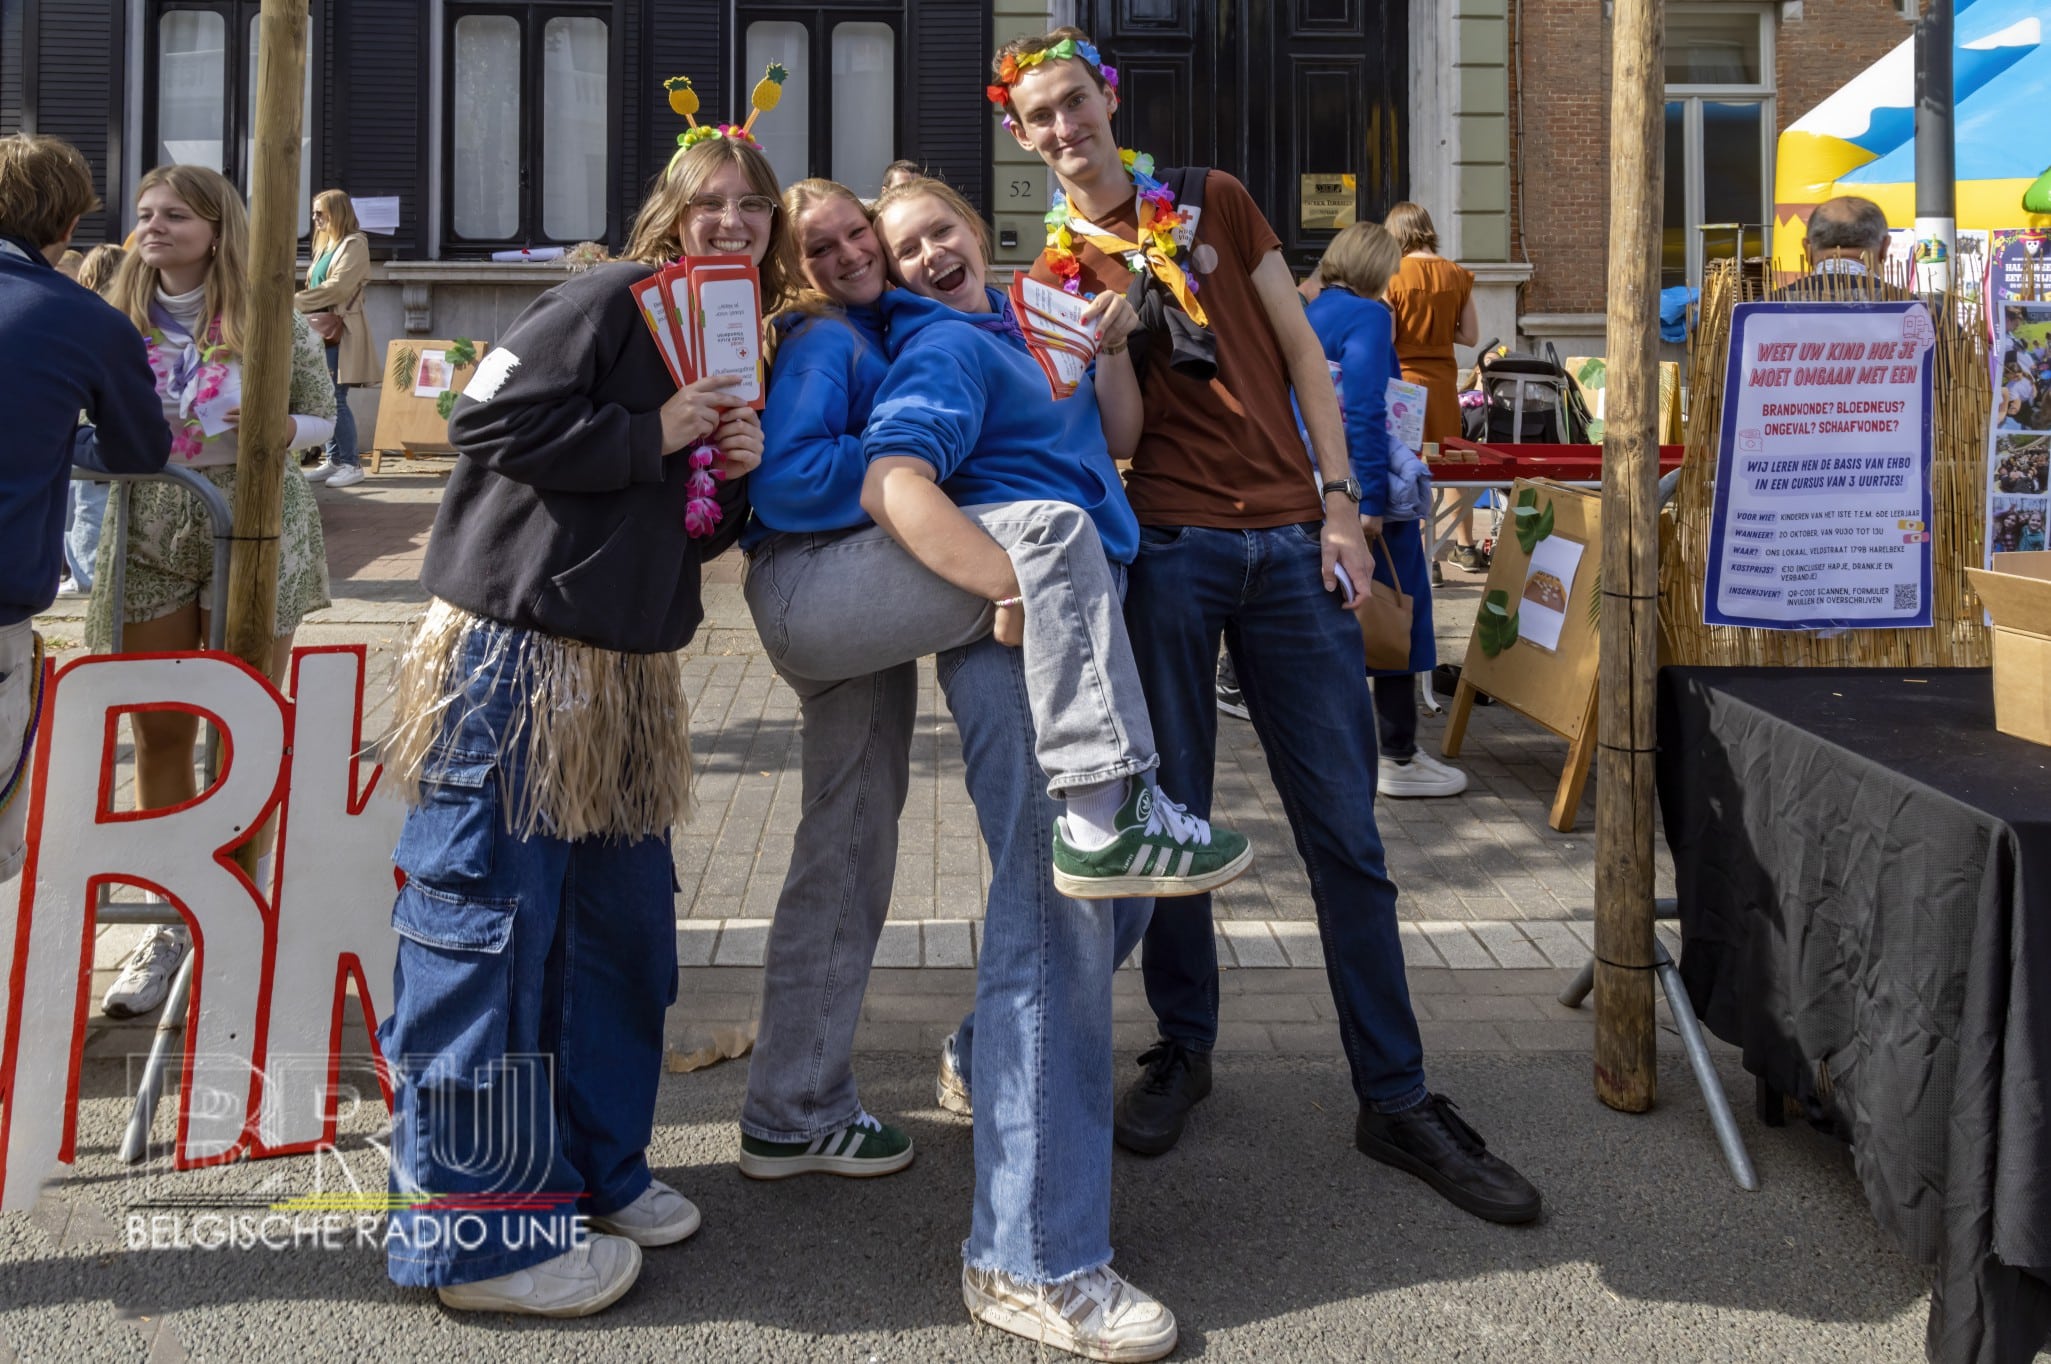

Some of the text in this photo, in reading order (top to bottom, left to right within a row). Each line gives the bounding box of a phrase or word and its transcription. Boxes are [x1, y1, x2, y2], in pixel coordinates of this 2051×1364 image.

[1009, 180, 1032, 198] 52
[1758, 341, 1917, 361] WEET UW KIND HOE JE
[1749, 366, 1917, 386] MOET OMGAAN MET EEN
[1763, 401, 1905, 416] BRANDWONDE? BLOEDNEUS?
[1765, 420, 1899, 435] ONGEVAL? SCHAAFWONDE?
[1747, 457, 1910, 472] WIJ LEREN HEN DE BASIS VAN EHBO
[1755, 475, 1903, 490] IN EEN CURSUS VAN 3 UURTJES!
[1737, 512, 1757, 521] VOOR
[1759, 513, 1775, 521] WIE?
[1780, 512, 1809, 520] KINDEREN
[1825, 511, 1835, 519] HET
[1875, 510, 1887, 518] 6DE
[1735, 529, 1773, 539] WANNEER?
[1733, 546, 1758, 556] WAAR?
[1810, 546, 1847, 555] VELDSTRAAT
[1869, 545, 1905, 553] HARELBEKE
[1731, 564, 1774, 574] KOSTPRIJS?
[1853, 562, 1882, 570] DRANKJE
[1729, 587, 1781, 597] INSCHRIJVEN?
[1788, 589, 1816, 597] QR-CODE
[1787, 598, 1815, 606] INVULLEN
